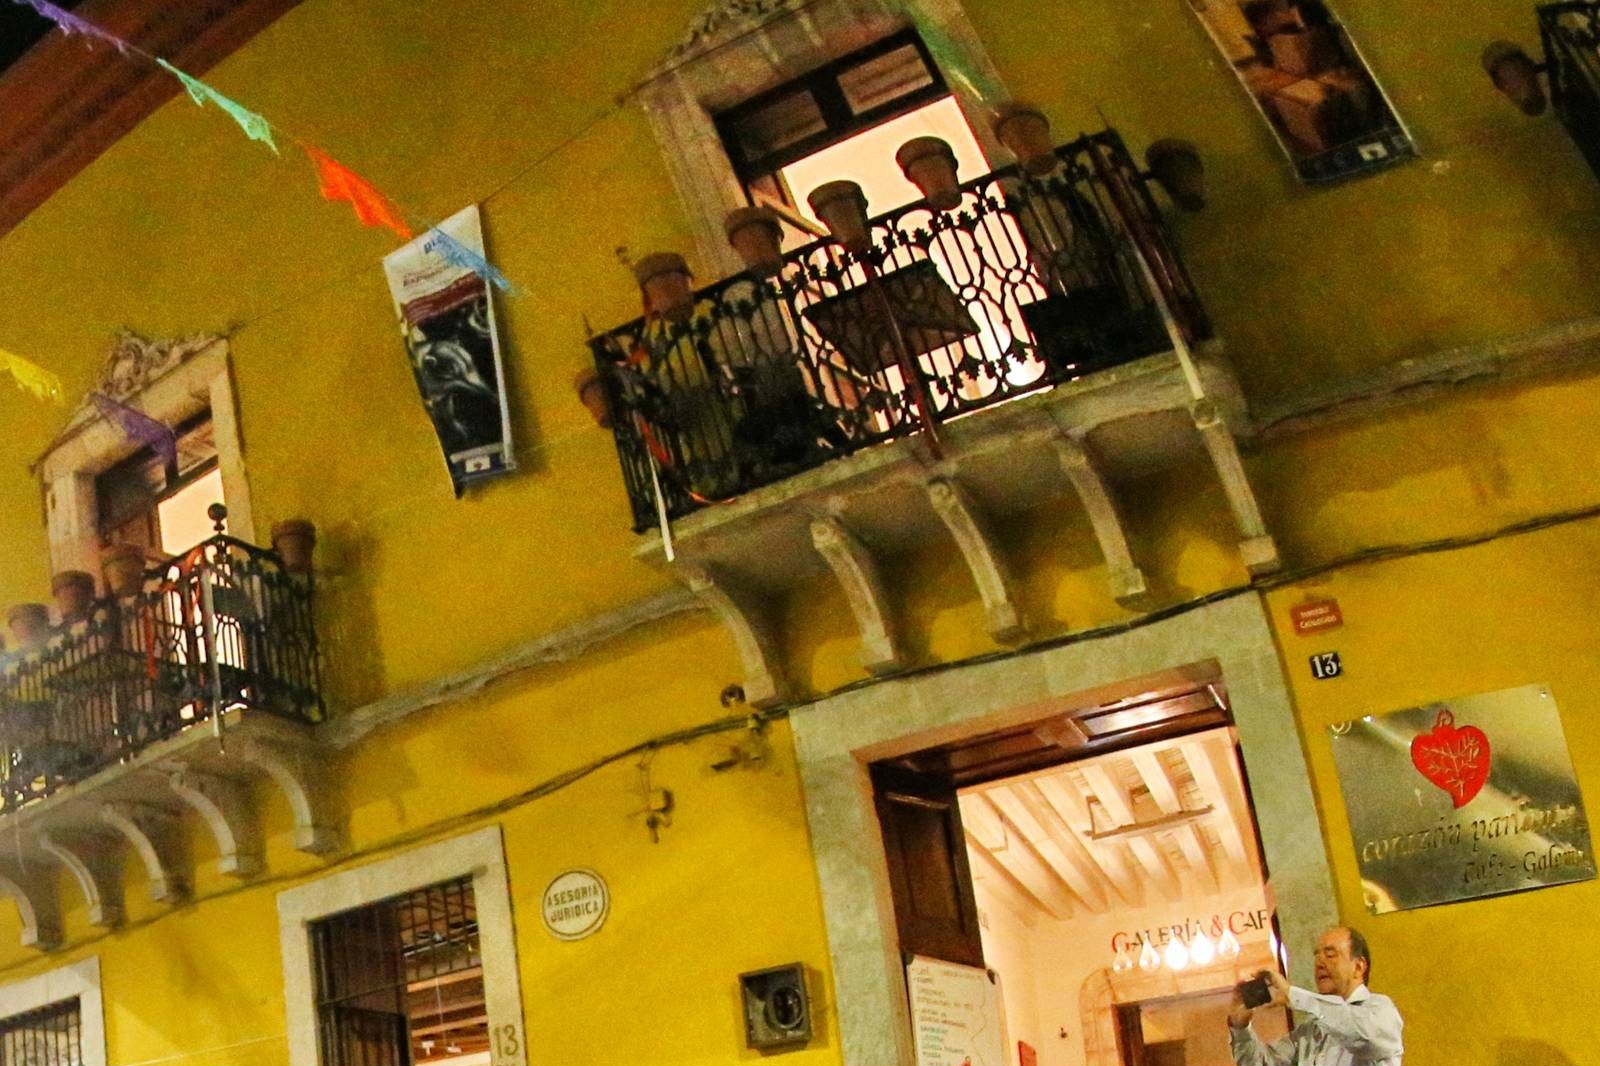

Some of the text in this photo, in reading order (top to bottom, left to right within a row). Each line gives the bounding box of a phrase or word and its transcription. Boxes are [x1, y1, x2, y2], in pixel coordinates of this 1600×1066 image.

[1312, 652, 1338, 678] 13
[1211, 914, 1224, 938] &
[1228, 908, 1269, 936] CAF
[494, 1024, 519, 1058] 13
